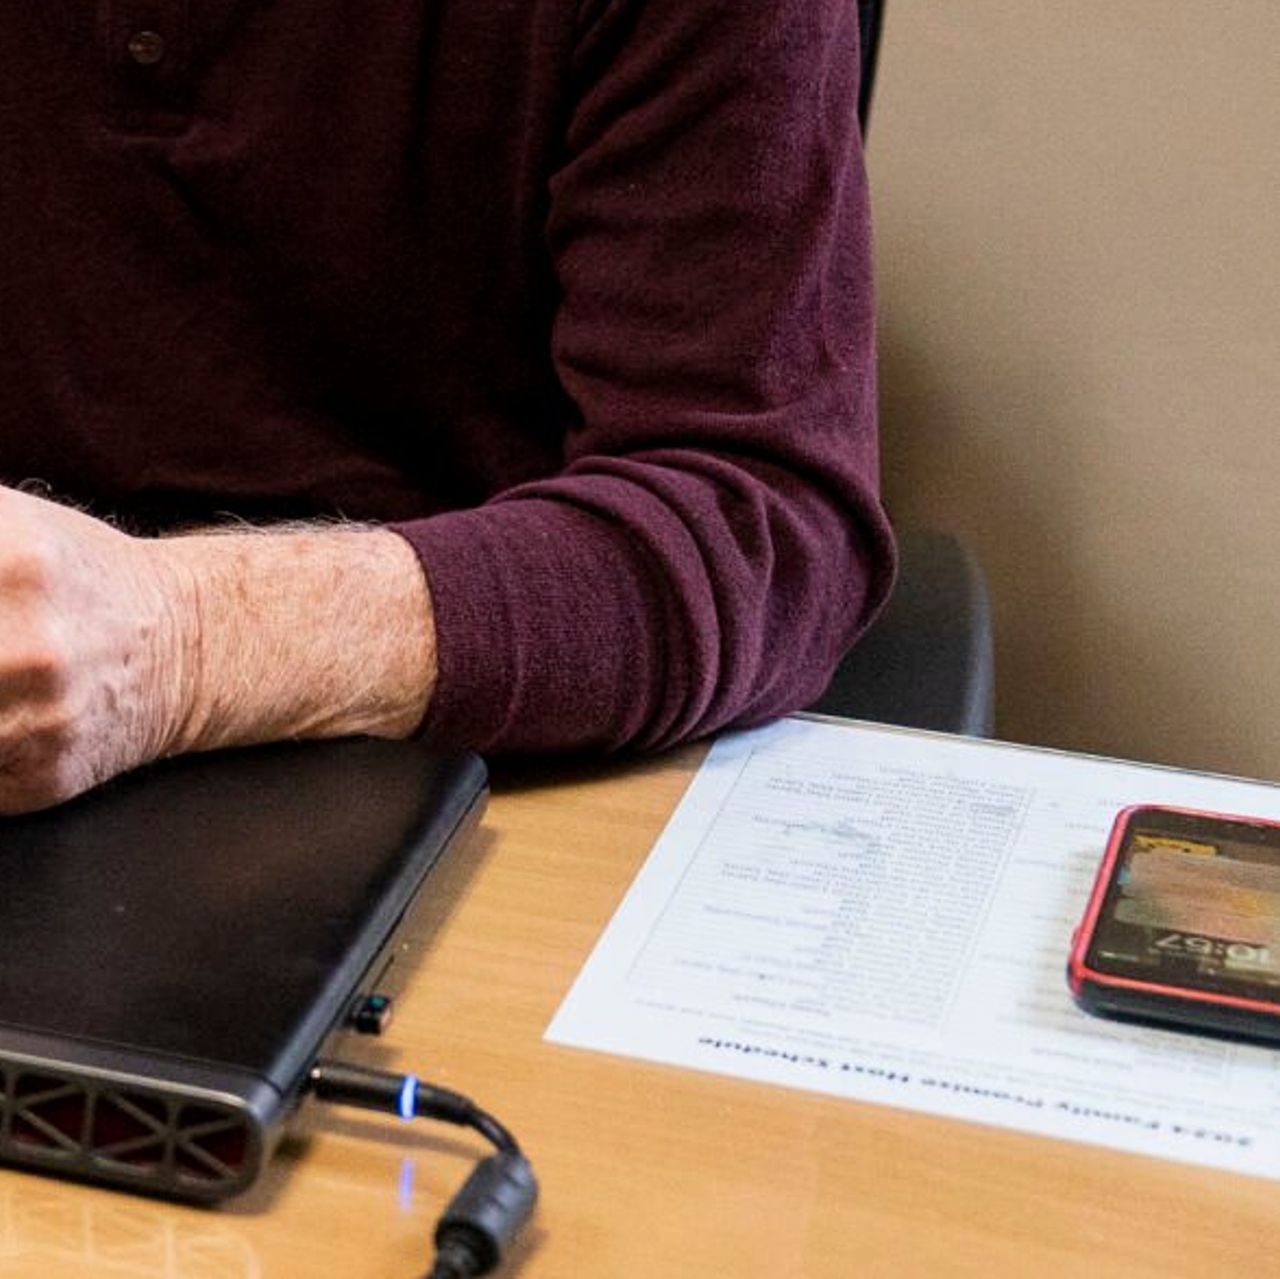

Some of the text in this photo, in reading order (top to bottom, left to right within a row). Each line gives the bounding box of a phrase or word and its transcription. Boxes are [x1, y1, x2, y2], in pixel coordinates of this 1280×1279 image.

[698, 1037, 828, 1068] Schedule
[841, 1063, 909, 1083] Host
[920, 1077, 1043, 1107] Promise
[1053, 1101, 1160, 1129] Family
[1171, 1123, 1255, 1146] 2024
